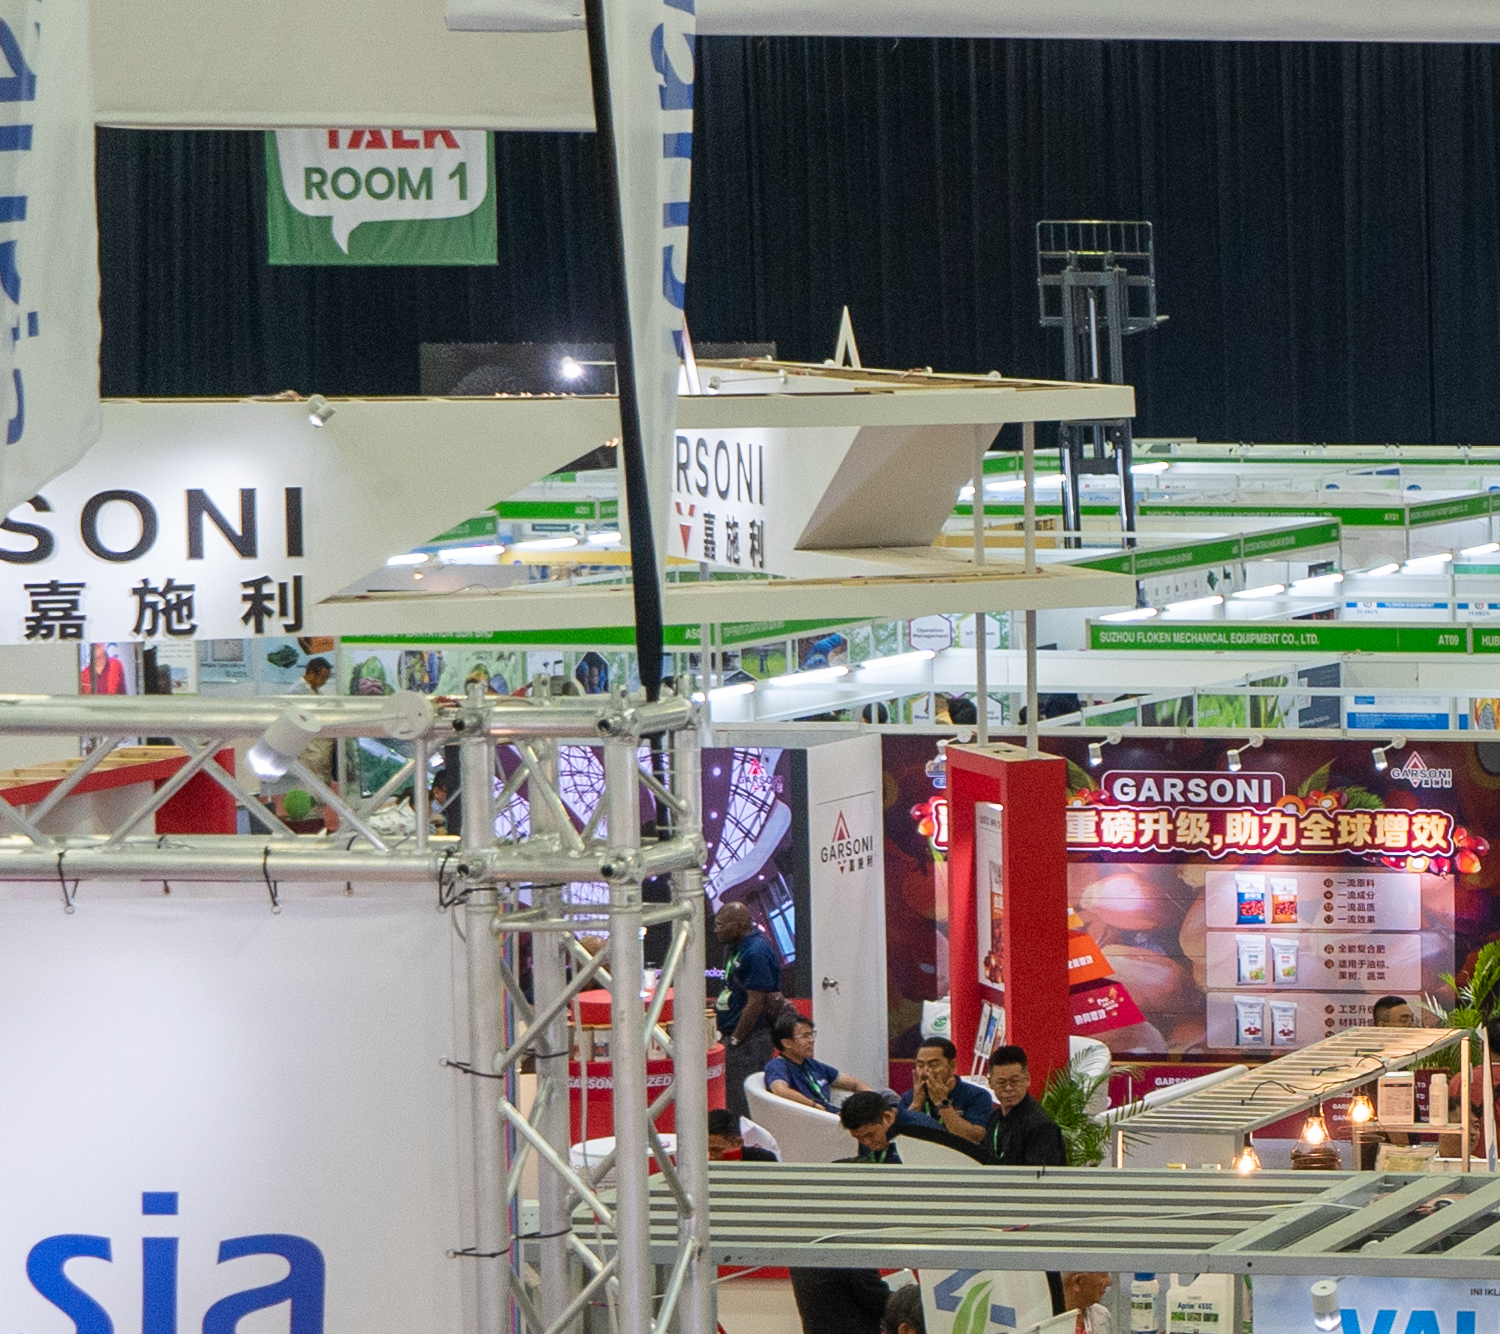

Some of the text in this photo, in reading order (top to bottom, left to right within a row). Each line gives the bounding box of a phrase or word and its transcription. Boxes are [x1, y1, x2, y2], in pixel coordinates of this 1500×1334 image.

[303, 162, 469, 202] ROOM 1
[704, 510, 765, 569] 嘉施利
[24, 576, 305, 642] 嘉施利
[1100, 632, 1320, 645] SUZHOU FLOKEN MECHANICAL EQUIPMENT LTD.
[1438, 634, 1460, 647] AT09
[1391, 768, 1452, 780] GARSONI
[1113, 777, 1272, 805] GARSONI
[820, 835, 874, 864] GARSONI
